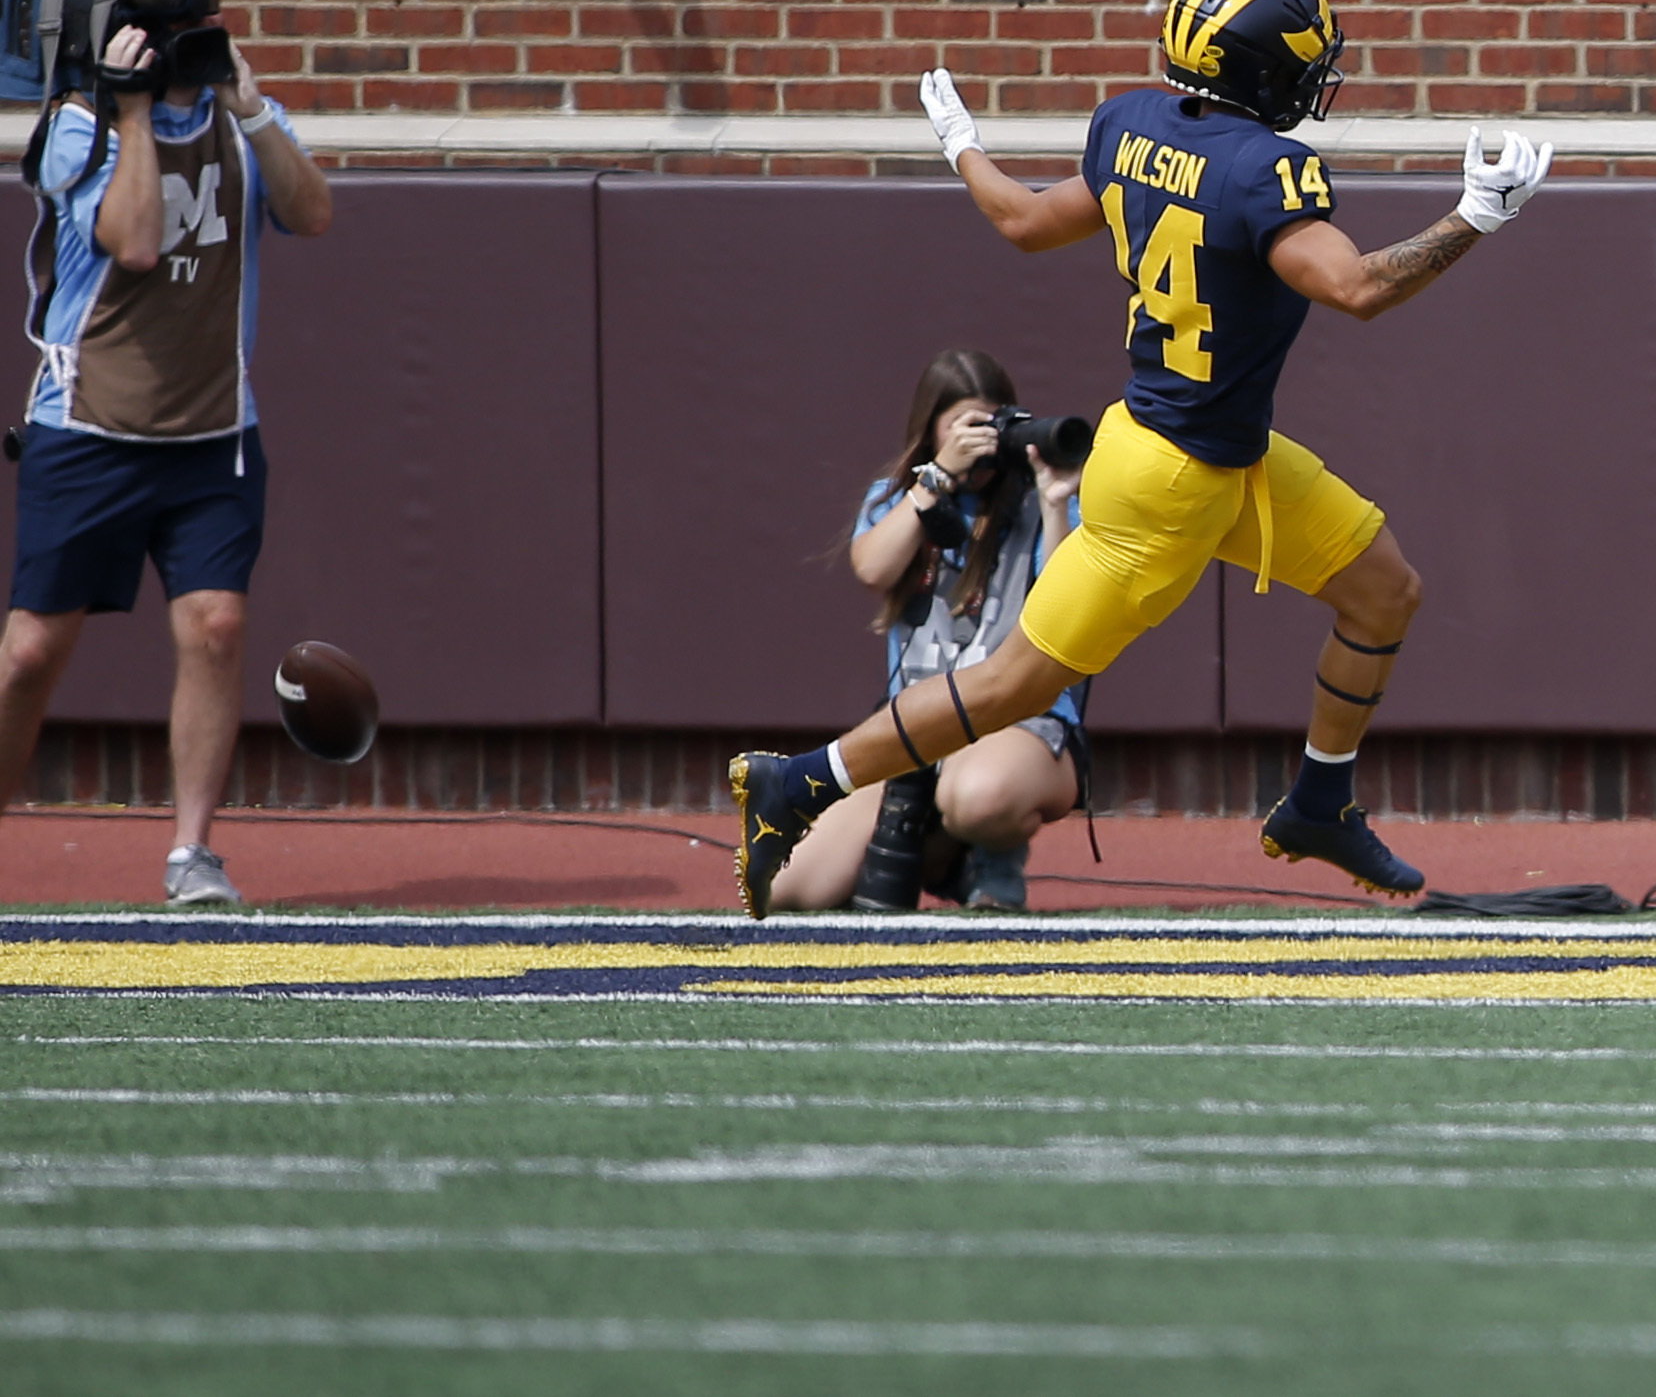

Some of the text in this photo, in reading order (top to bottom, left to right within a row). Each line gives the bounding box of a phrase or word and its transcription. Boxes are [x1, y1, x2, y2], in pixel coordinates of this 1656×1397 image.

[1114, 131, 1207, 199] WILSON
[1274, 156, 1331, 211] 14
[159, 162, 228, 255] M
[168, 254, 200, 283] TV
[1100, 181, 1214, 383] 14
